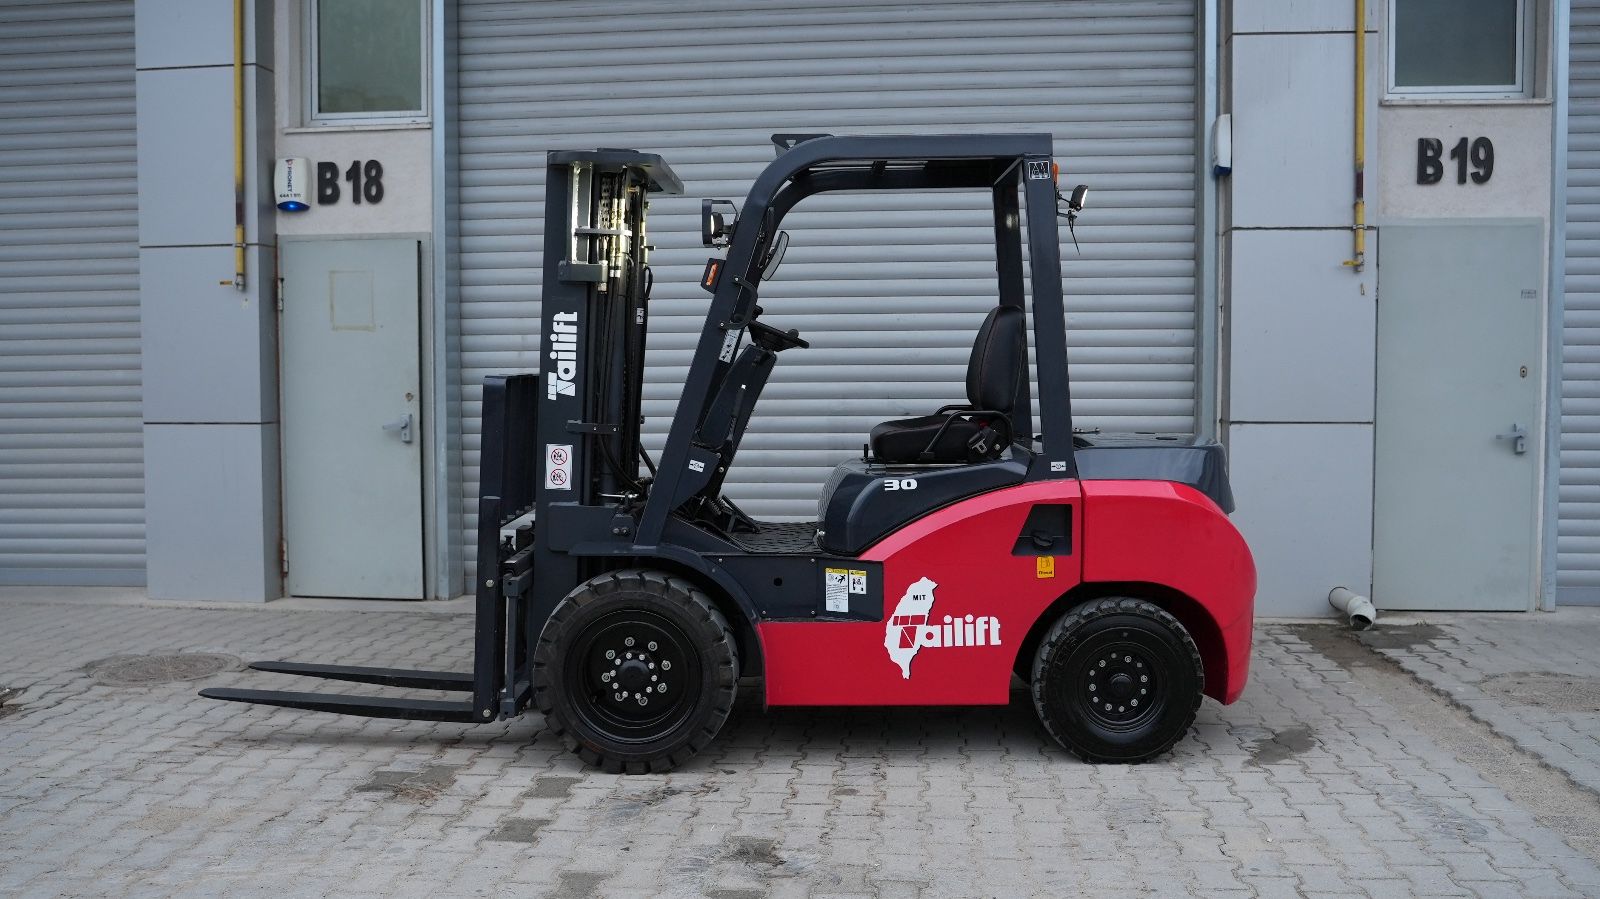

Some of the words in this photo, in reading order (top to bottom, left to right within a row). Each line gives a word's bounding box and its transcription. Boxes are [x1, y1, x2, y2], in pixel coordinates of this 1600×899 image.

[318, 159, 385, 205] B18
[1416, 136, 1495, 185] B19
[547, 311, 578, 401] Tailift
[884, 478, 918, 491] 30
[892, 613, 1002, 649] Tailift
